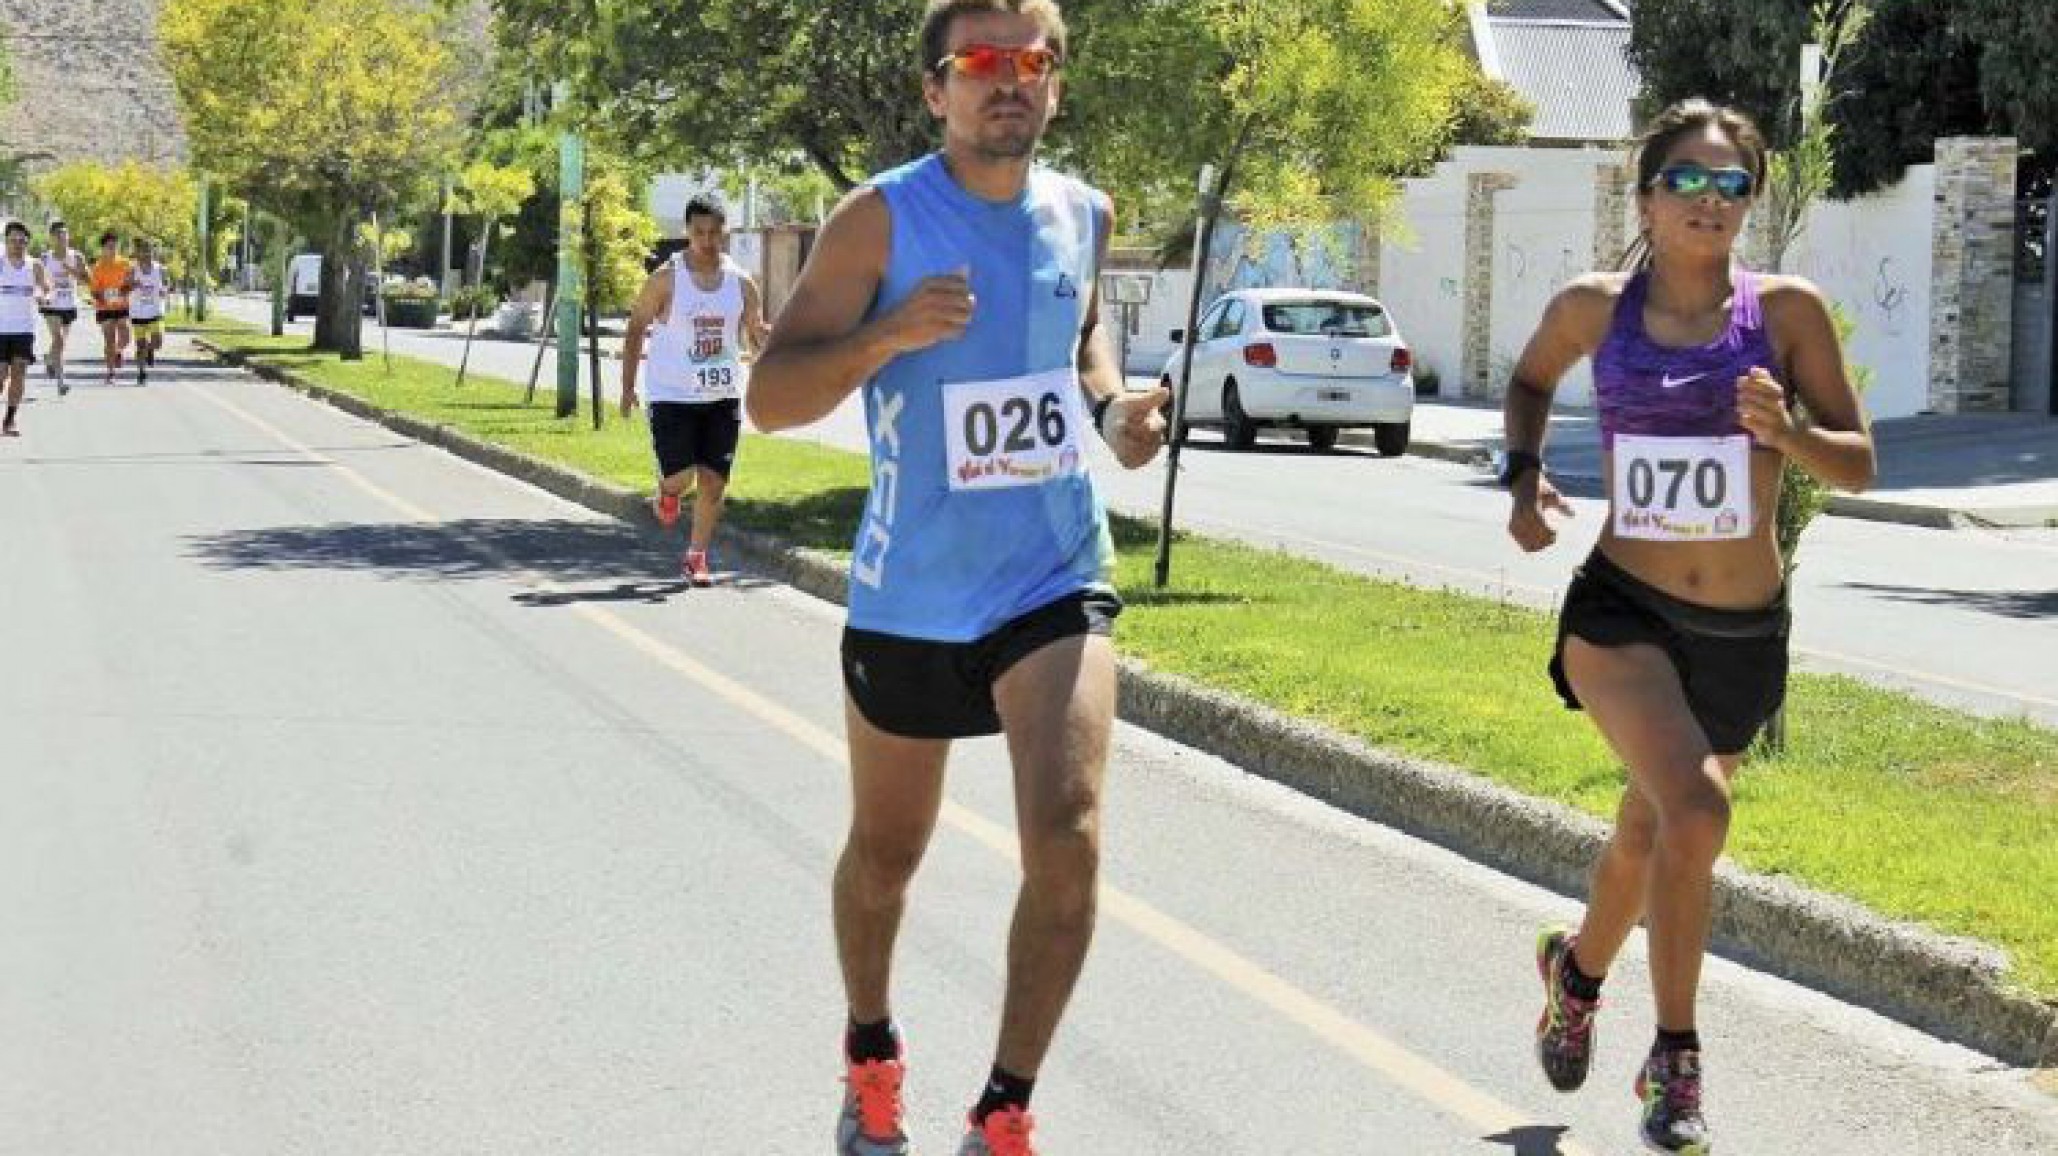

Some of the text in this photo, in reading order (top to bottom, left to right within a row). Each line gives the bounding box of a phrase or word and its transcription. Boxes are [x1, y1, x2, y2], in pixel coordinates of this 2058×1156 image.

[697, 367, 731, 387] 193
[964, 391, 1065, 457] 026
[1627, 458, 1726, 509] 070
